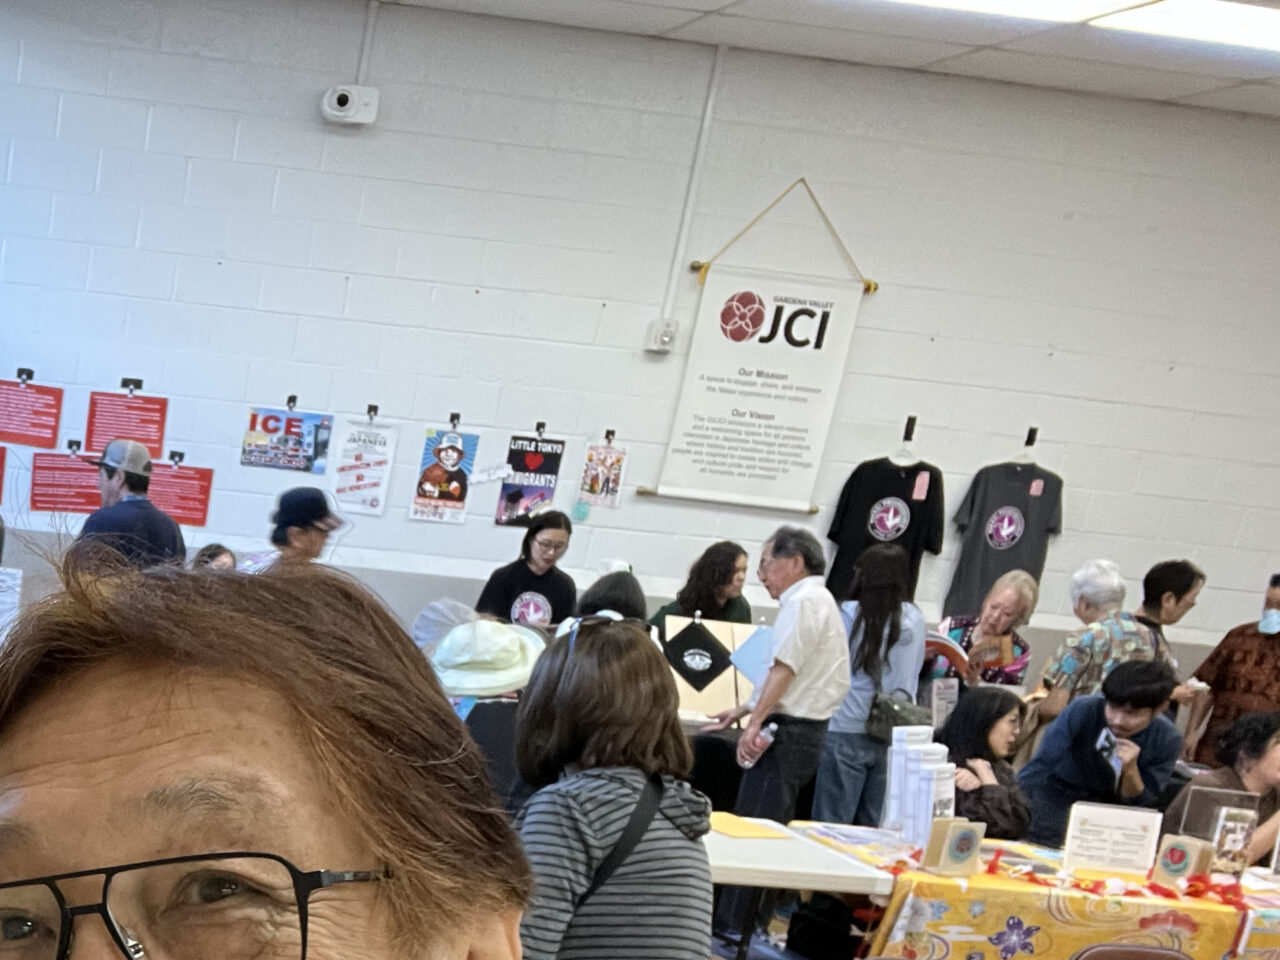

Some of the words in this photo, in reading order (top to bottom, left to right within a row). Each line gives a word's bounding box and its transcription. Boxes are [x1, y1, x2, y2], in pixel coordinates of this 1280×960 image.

[758, 304, 831, 350] JCI
[249, 413, 304, 437] ICE
[510, 440, 537, 452] LITTLE
[538, 442, 563, 454] TOKYO
